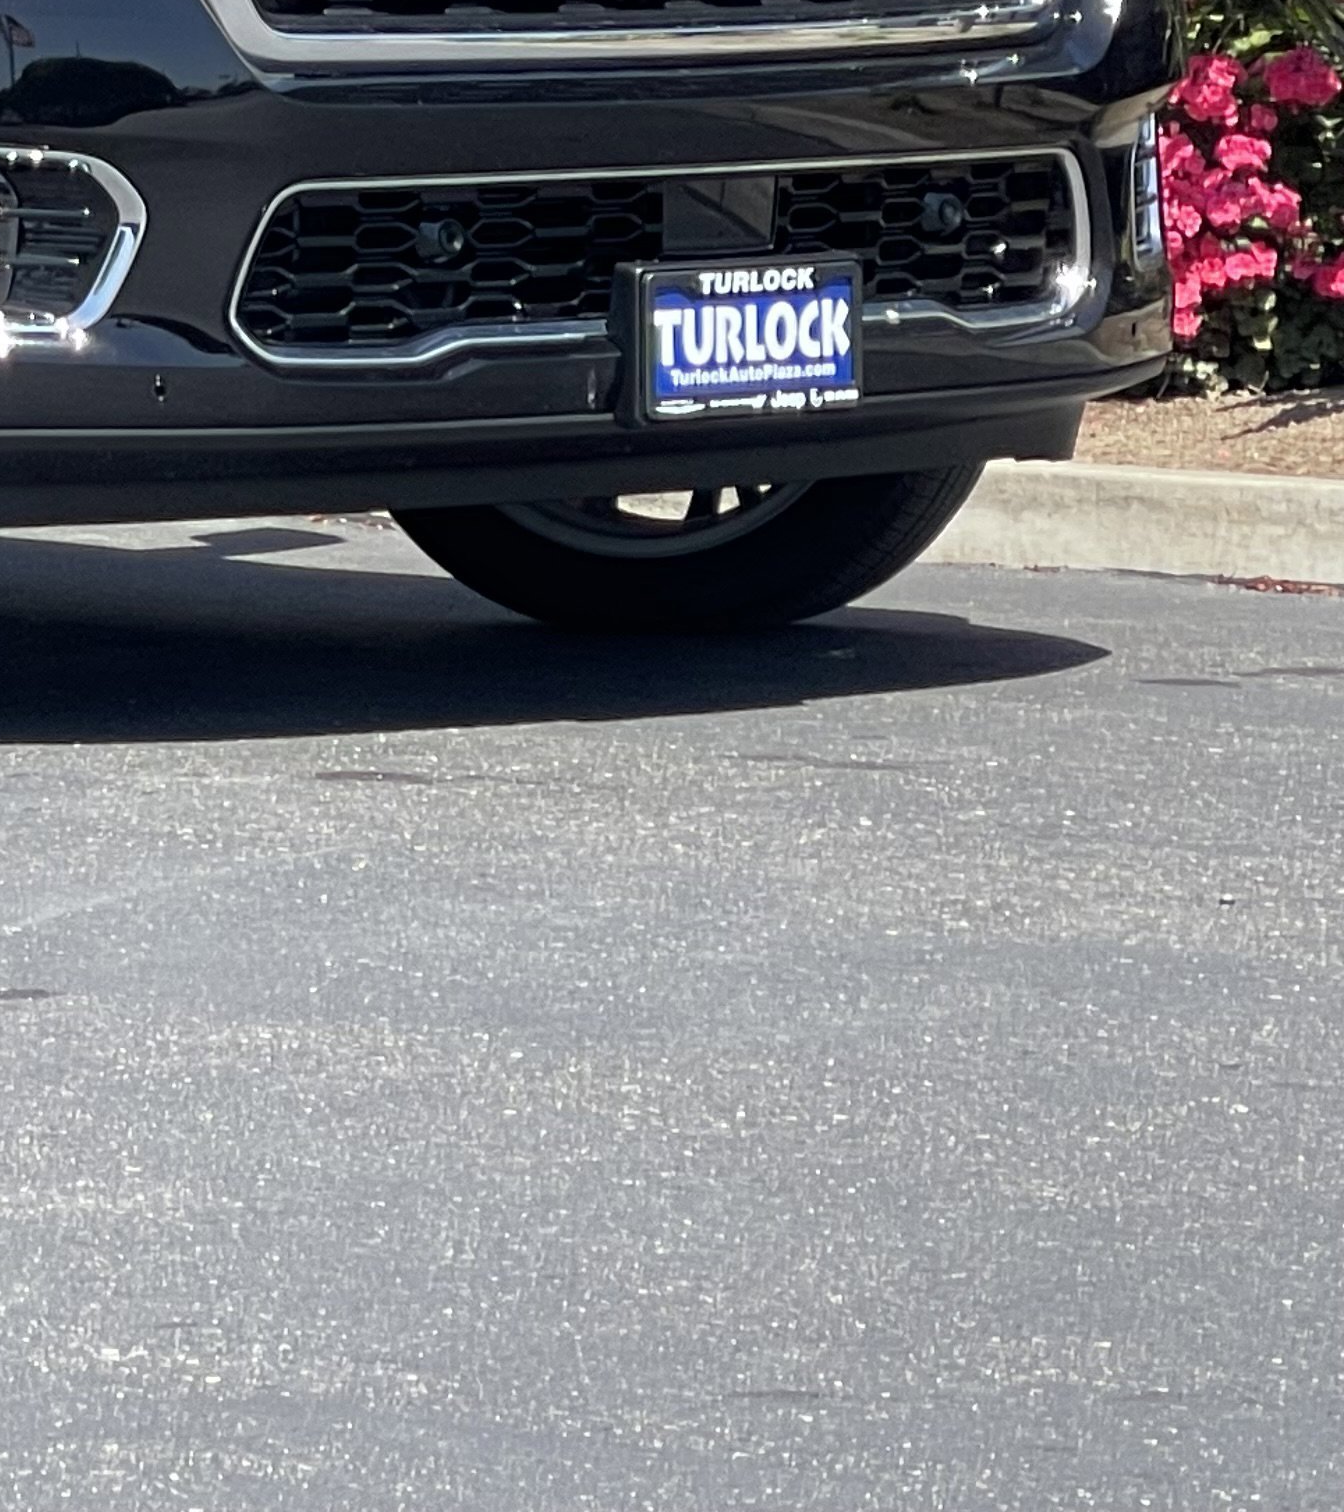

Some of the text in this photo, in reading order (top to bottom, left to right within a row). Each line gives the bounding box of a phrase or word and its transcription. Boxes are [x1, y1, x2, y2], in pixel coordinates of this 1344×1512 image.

[699, 267, 815, 295] TURLOCK
[653, 298, 851, 367] TURLOCK
[670, 362, 837, 387] TurlockAutoPlaza.com
